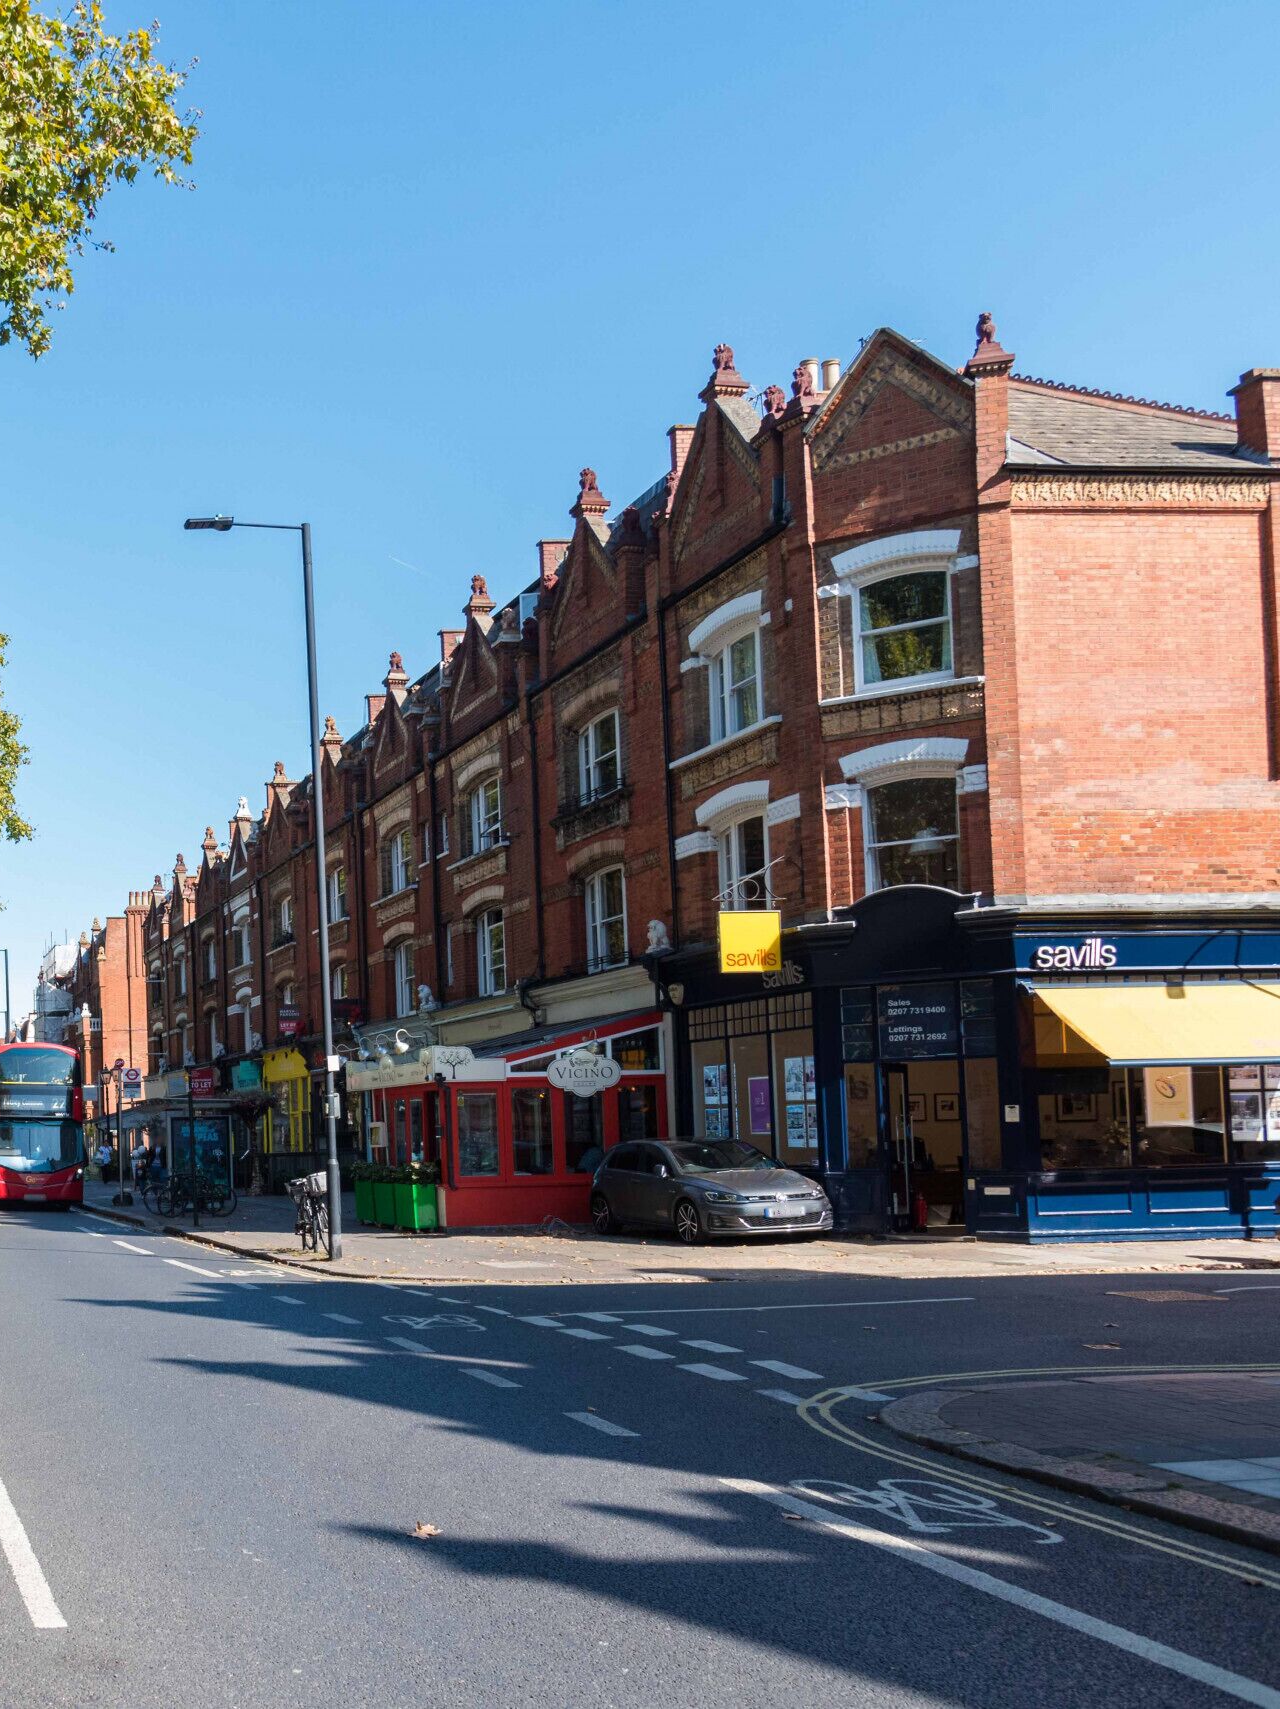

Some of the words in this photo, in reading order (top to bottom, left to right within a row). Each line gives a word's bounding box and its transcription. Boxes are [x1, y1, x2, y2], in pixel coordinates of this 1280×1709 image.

[726, 948, 777, 967] savills
[1035, 937, 1117, 968] savills
[887, 999, 911, 1007] Sales
[887, 1008, 908, 1016] 0207
[888, 1025, 923, 1034] Lettings
[888, 1034, 909, 1042] 0207
[926, 1032, 948, 1040] 2692
[555, 1066, 613, 1079] VICINO
